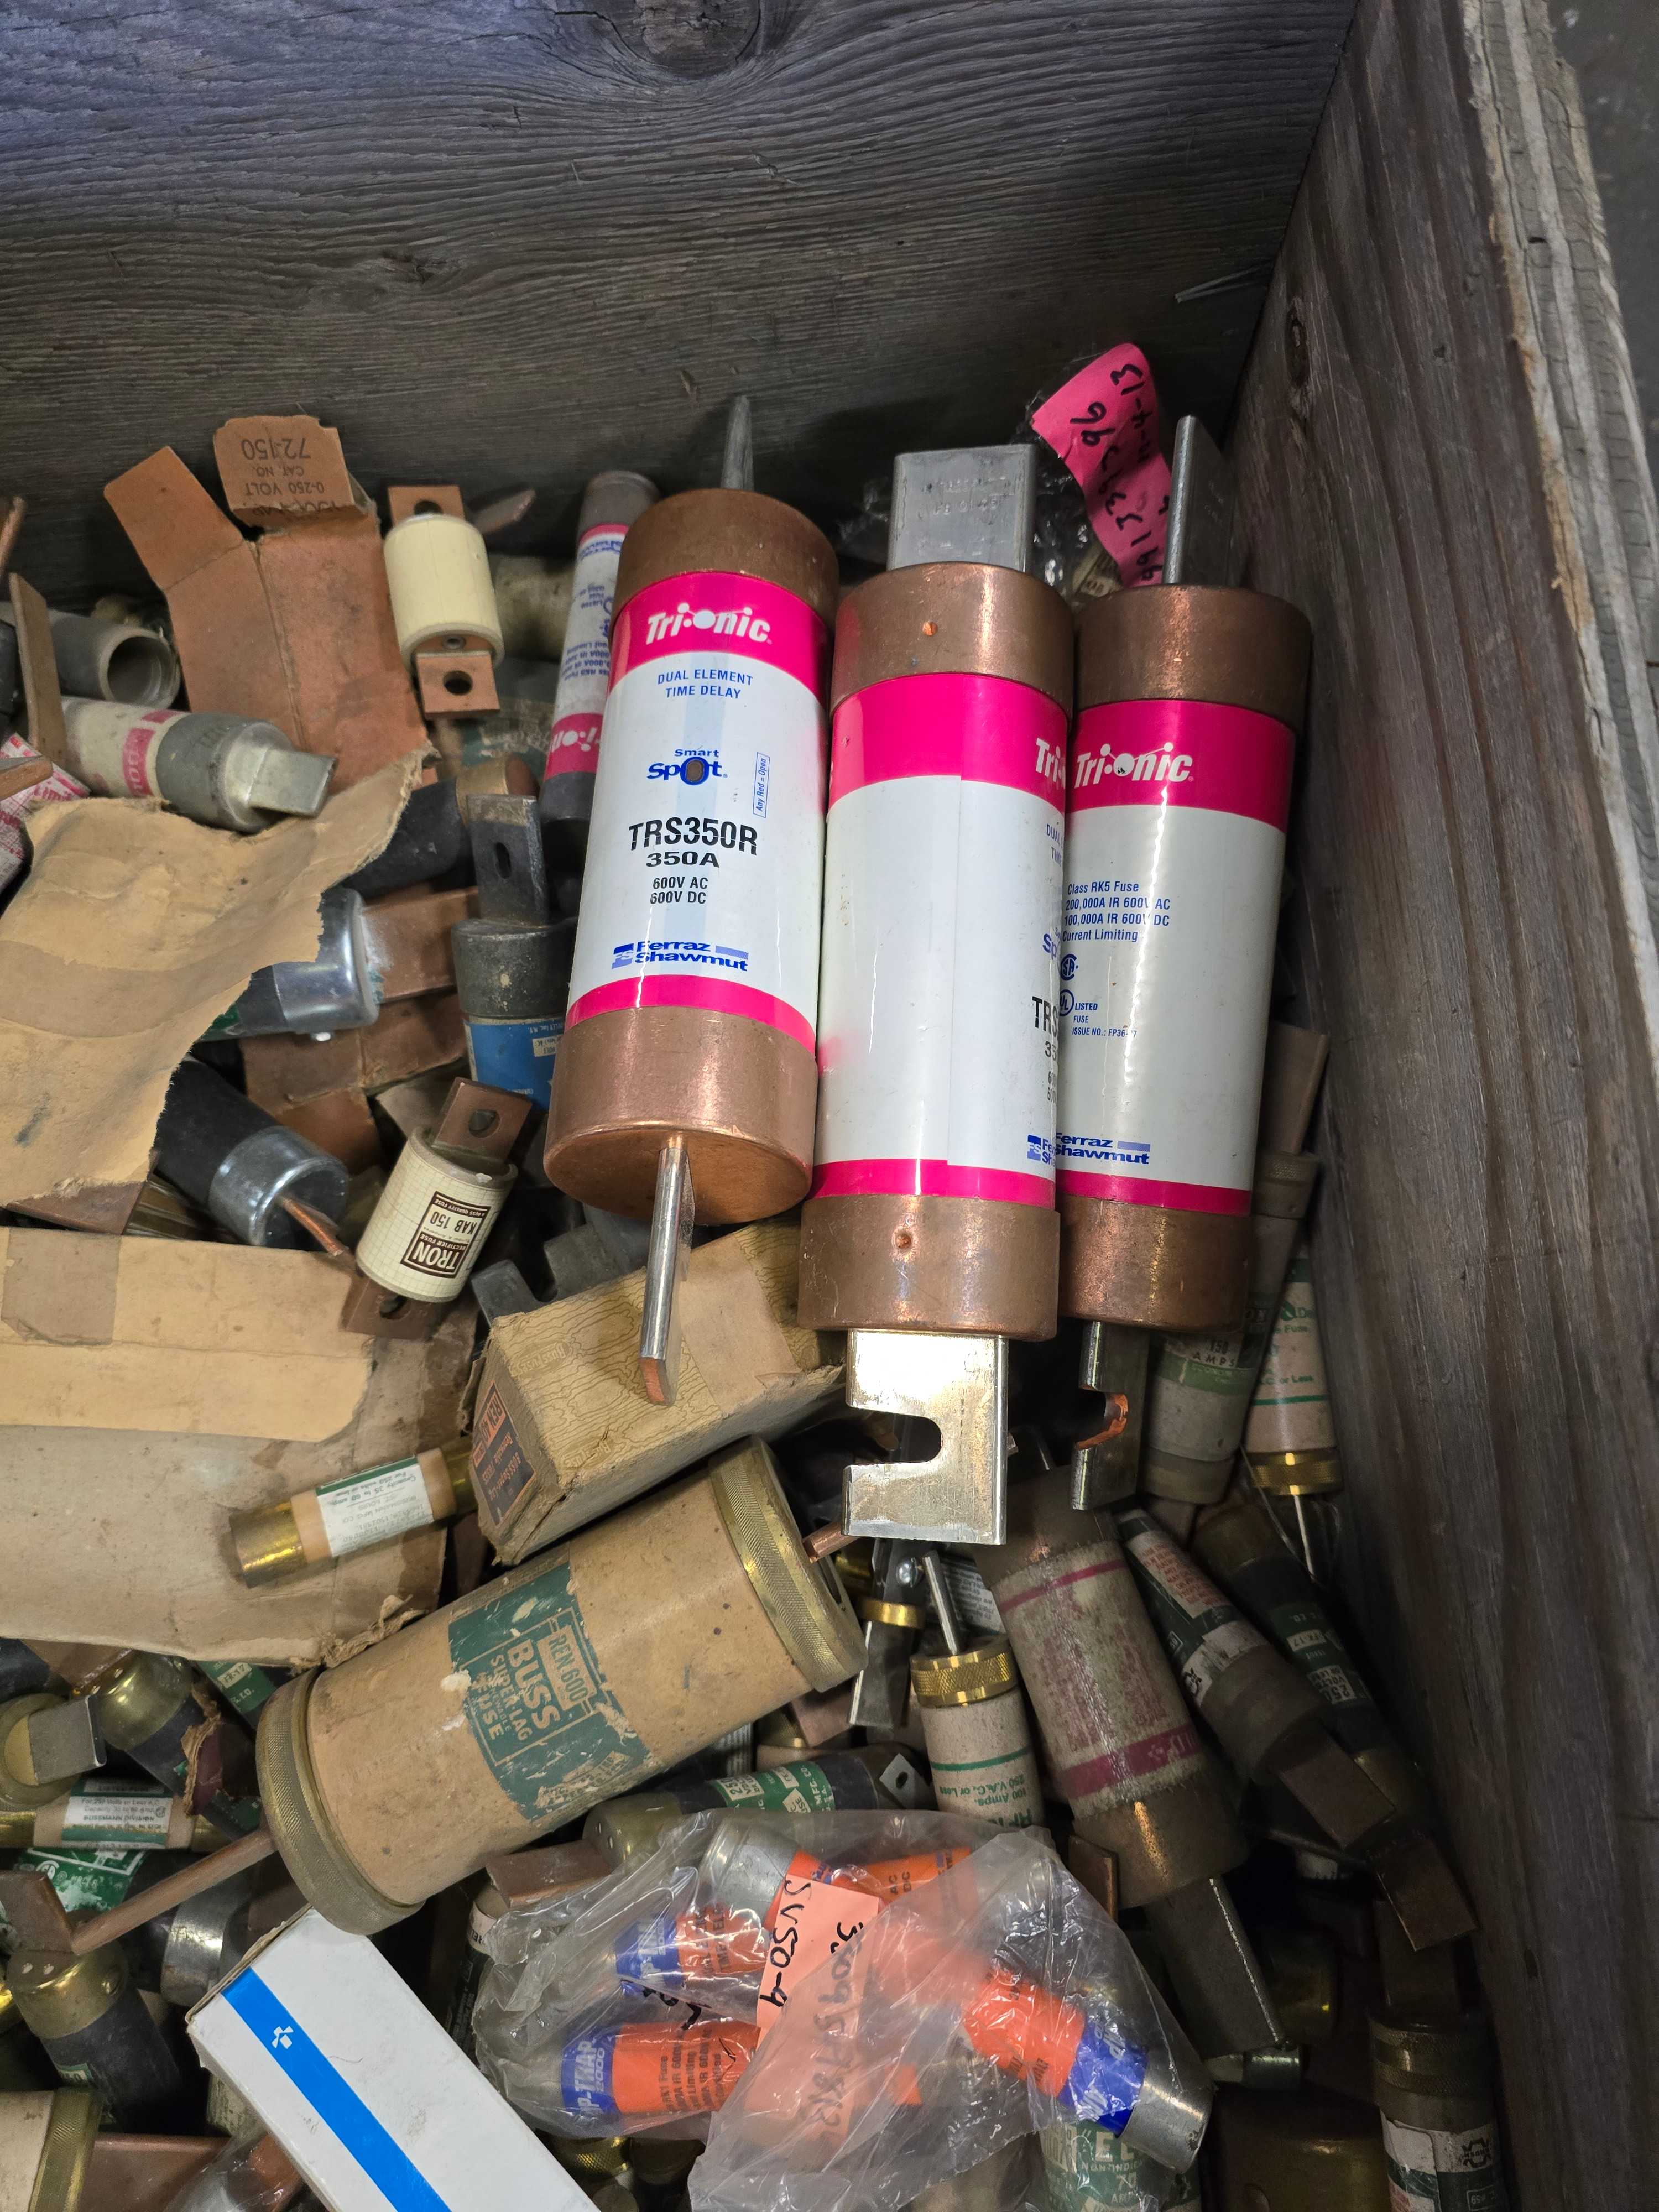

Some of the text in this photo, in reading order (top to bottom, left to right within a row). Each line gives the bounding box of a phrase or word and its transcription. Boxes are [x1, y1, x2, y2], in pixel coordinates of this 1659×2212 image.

[241, 437, 311, 460] 72-150
[246, 482, 283, 496] VOLT
[658, 669, 753, 686] DUAL ELEMENT
[666, 686, 741, 699] TIME DELAY
[759, 758, 767, 775] Open
[629, 817, 758, 855] TRS350R
[646, 852, 720, 868] 350A
[653, 877, 708, 889] 600V AC
[1067, 881, 1139, 895] Class RK5 Fuse
[650, 891, 706, 905] 600V DC
[1066, 898, 1105, 911] 200,000A
[1109, 898, 1120, 909] IR
[1155, 899, 1171, 910] AC
[1064, 914, 1103, 926] 100,000A
[1107, 914, 1118, 924] IR
[1154, 914, 1170, 926] DC
[1062, 929, 1092, 942] Current
[1095, 929, 1138, 943] Limiting
[636, 941, 711, 952] Ferraz
[634, 952, 748, 972] Shawmut
[1074, 1003, 1098, 1011] LISTED
[1073, 1015, 1089, 1024] FUSE
[1072, 1027, 1090, 1036] ISSUE
[435, 1199, 448, 1207] FUSE
[430, 1211, 478, 1235] KAB 150
[420, 1233, 435, 1244] FUSE
[413, 1241, 460, 1270] TRON
[1192, 1352, 1236, 1367] AMPS
[549, 1634, 588, 1701] REN 600
[507, 1639, 560, 1729] BUSS
